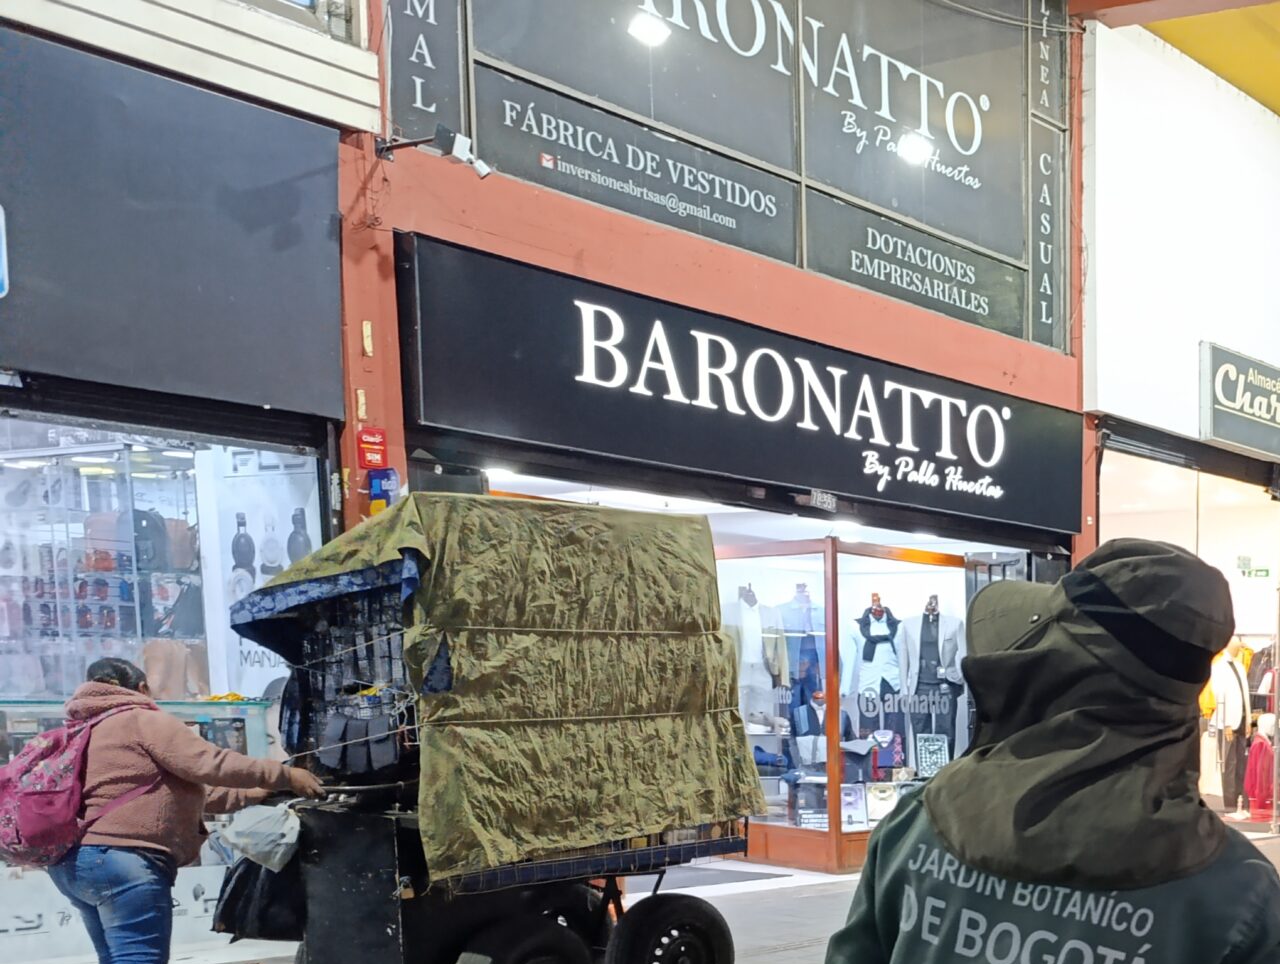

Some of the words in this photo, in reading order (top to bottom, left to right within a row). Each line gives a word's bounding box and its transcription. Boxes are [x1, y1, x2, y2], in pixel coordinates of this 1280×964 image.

[502, 99, 621, 165] FÁBRICA
[625, 143, 662, 179] DE
[666, 158, 778, 218] VESTIDOS
[840, 110, 869, 154] By
[556, 155, 737, 229] inversionesbrtsas@gmail.com
[866, 227, 976, 285] DOTACIONES
[1039, 152, 1053, 324] CASUAL
[850, 249, 989, 316] EMPRESARIALES
[862, 450, 892, 492] By
[944, 465, 1004, 499] Huertas
[900, 884, 946, 946] DE
